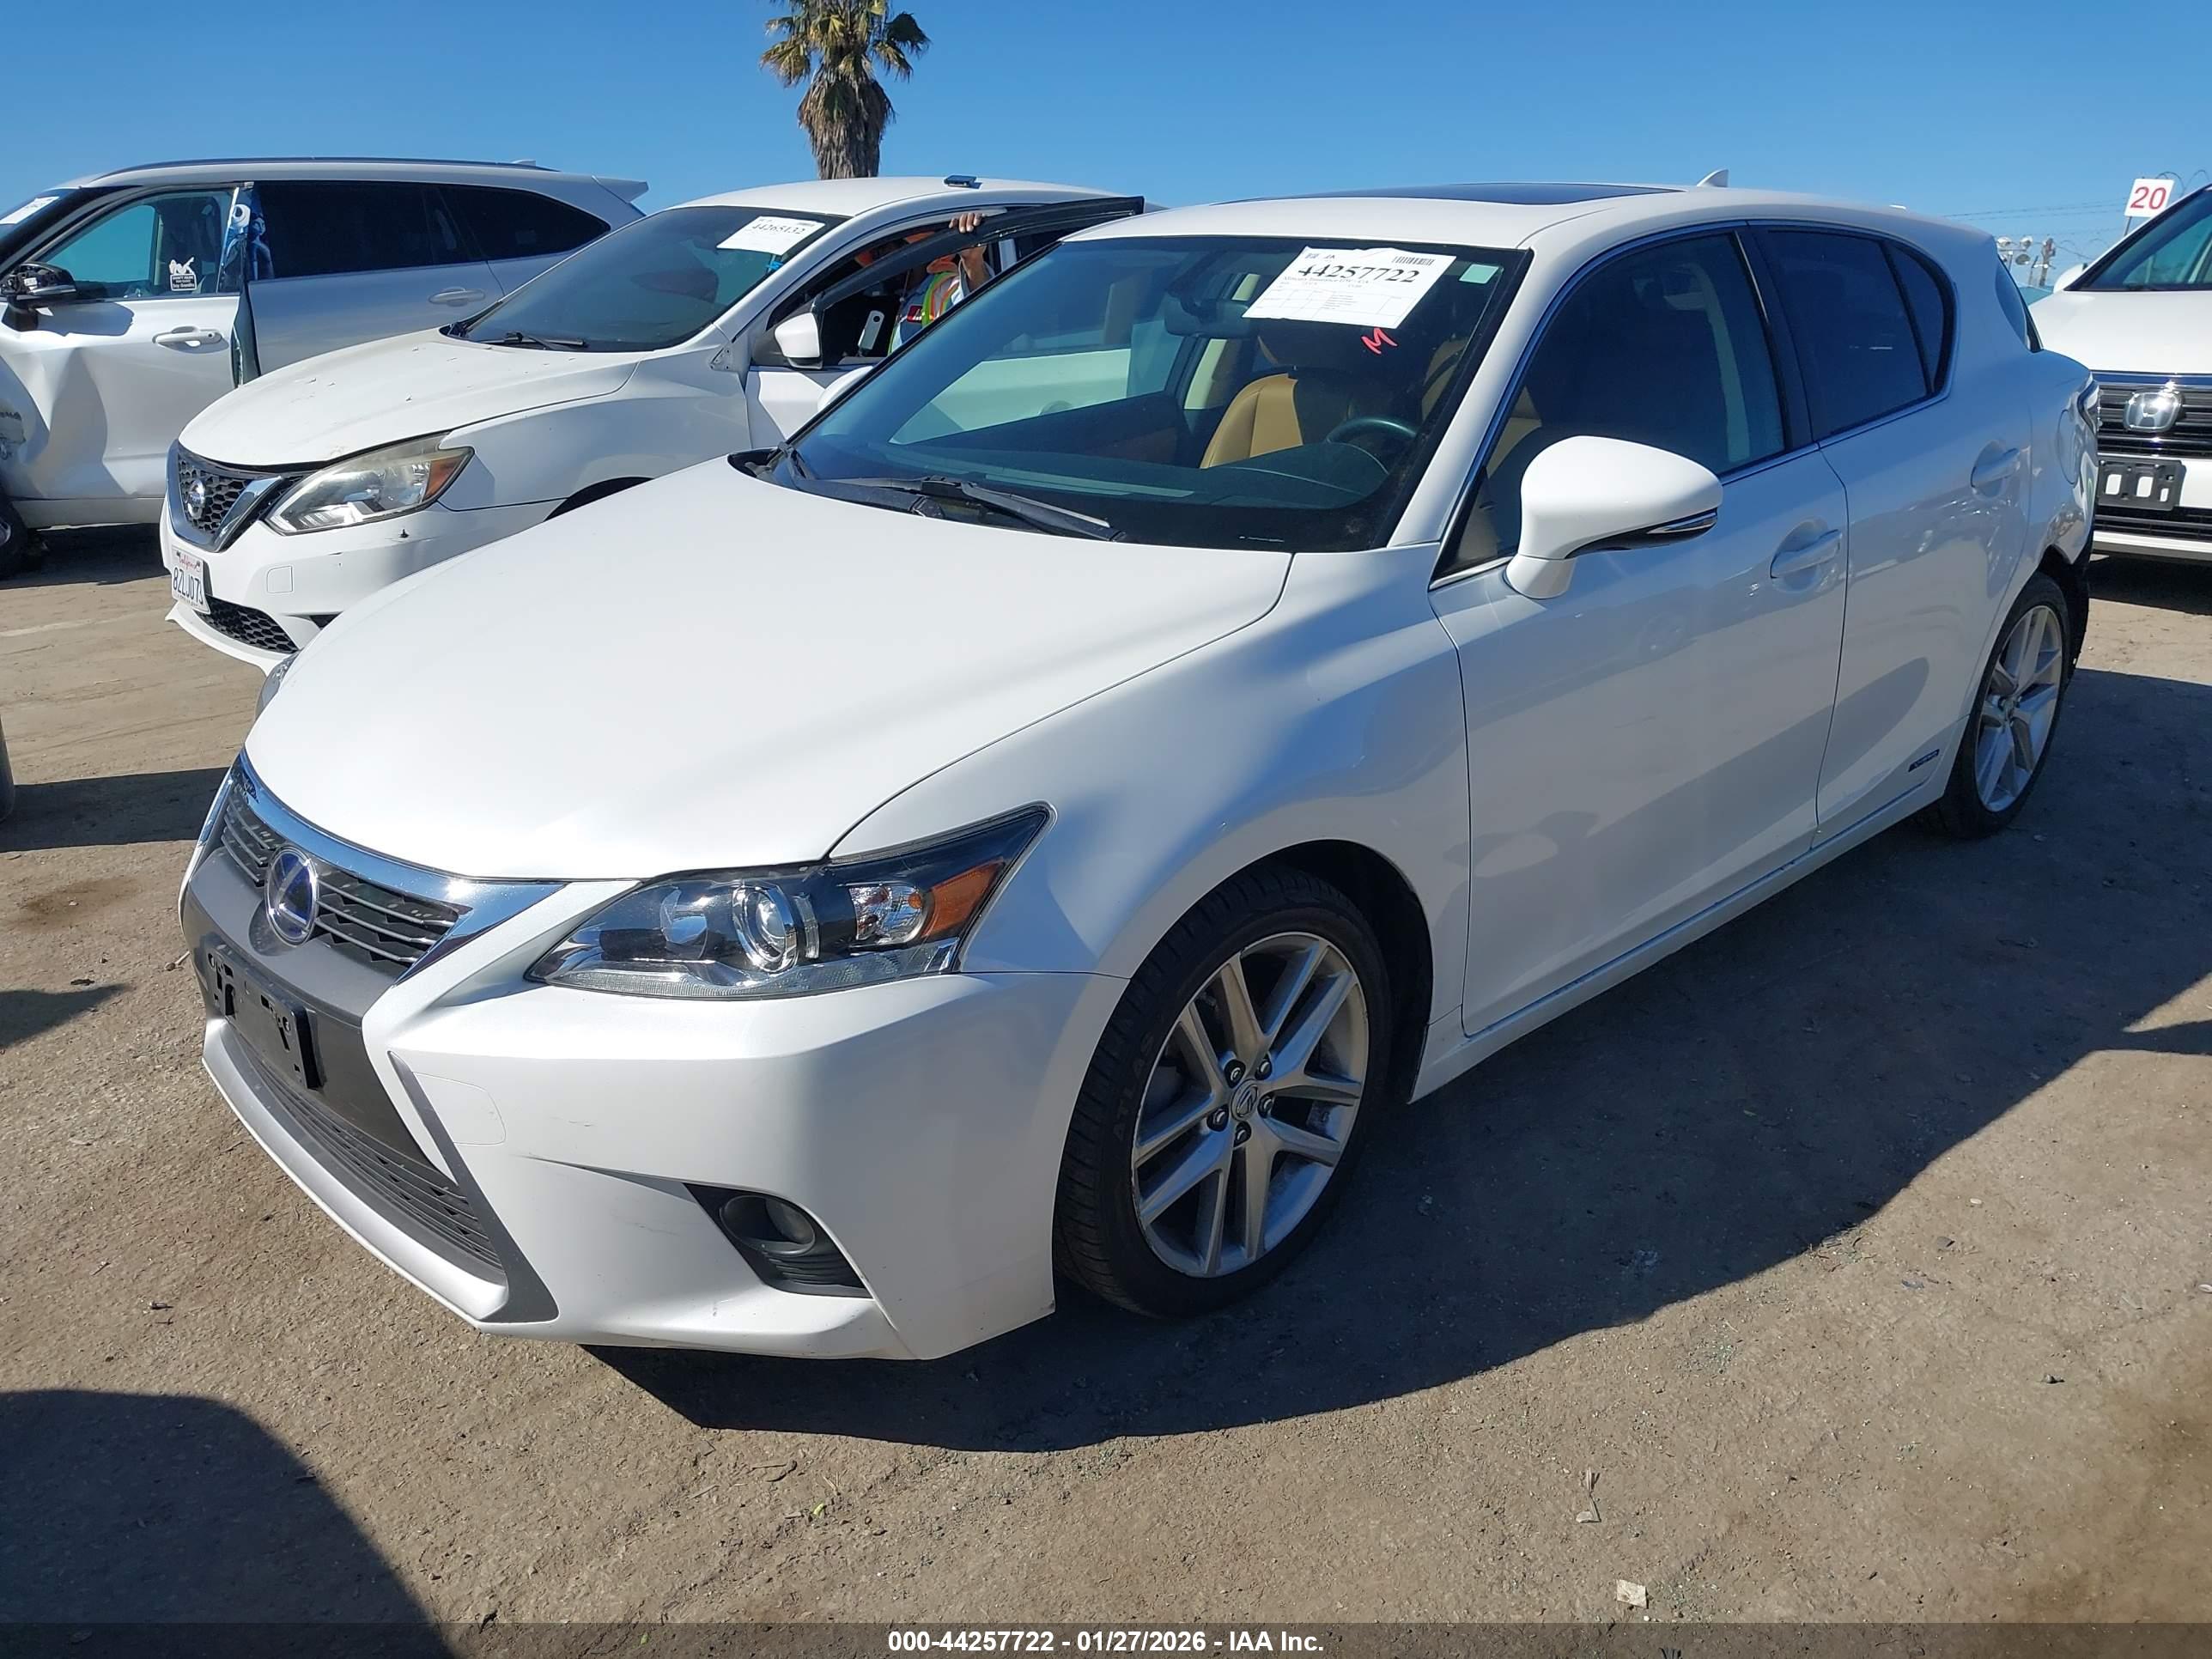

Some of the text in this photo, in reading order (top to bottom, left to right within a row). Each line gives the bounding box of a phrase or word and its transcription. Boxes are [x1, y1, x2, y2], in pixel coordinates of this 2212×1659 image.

[2130, 185, 2166, 210] 20
[1297, 264, 1420, 283] 44257722
[1361, 326, 1398, 356] M
